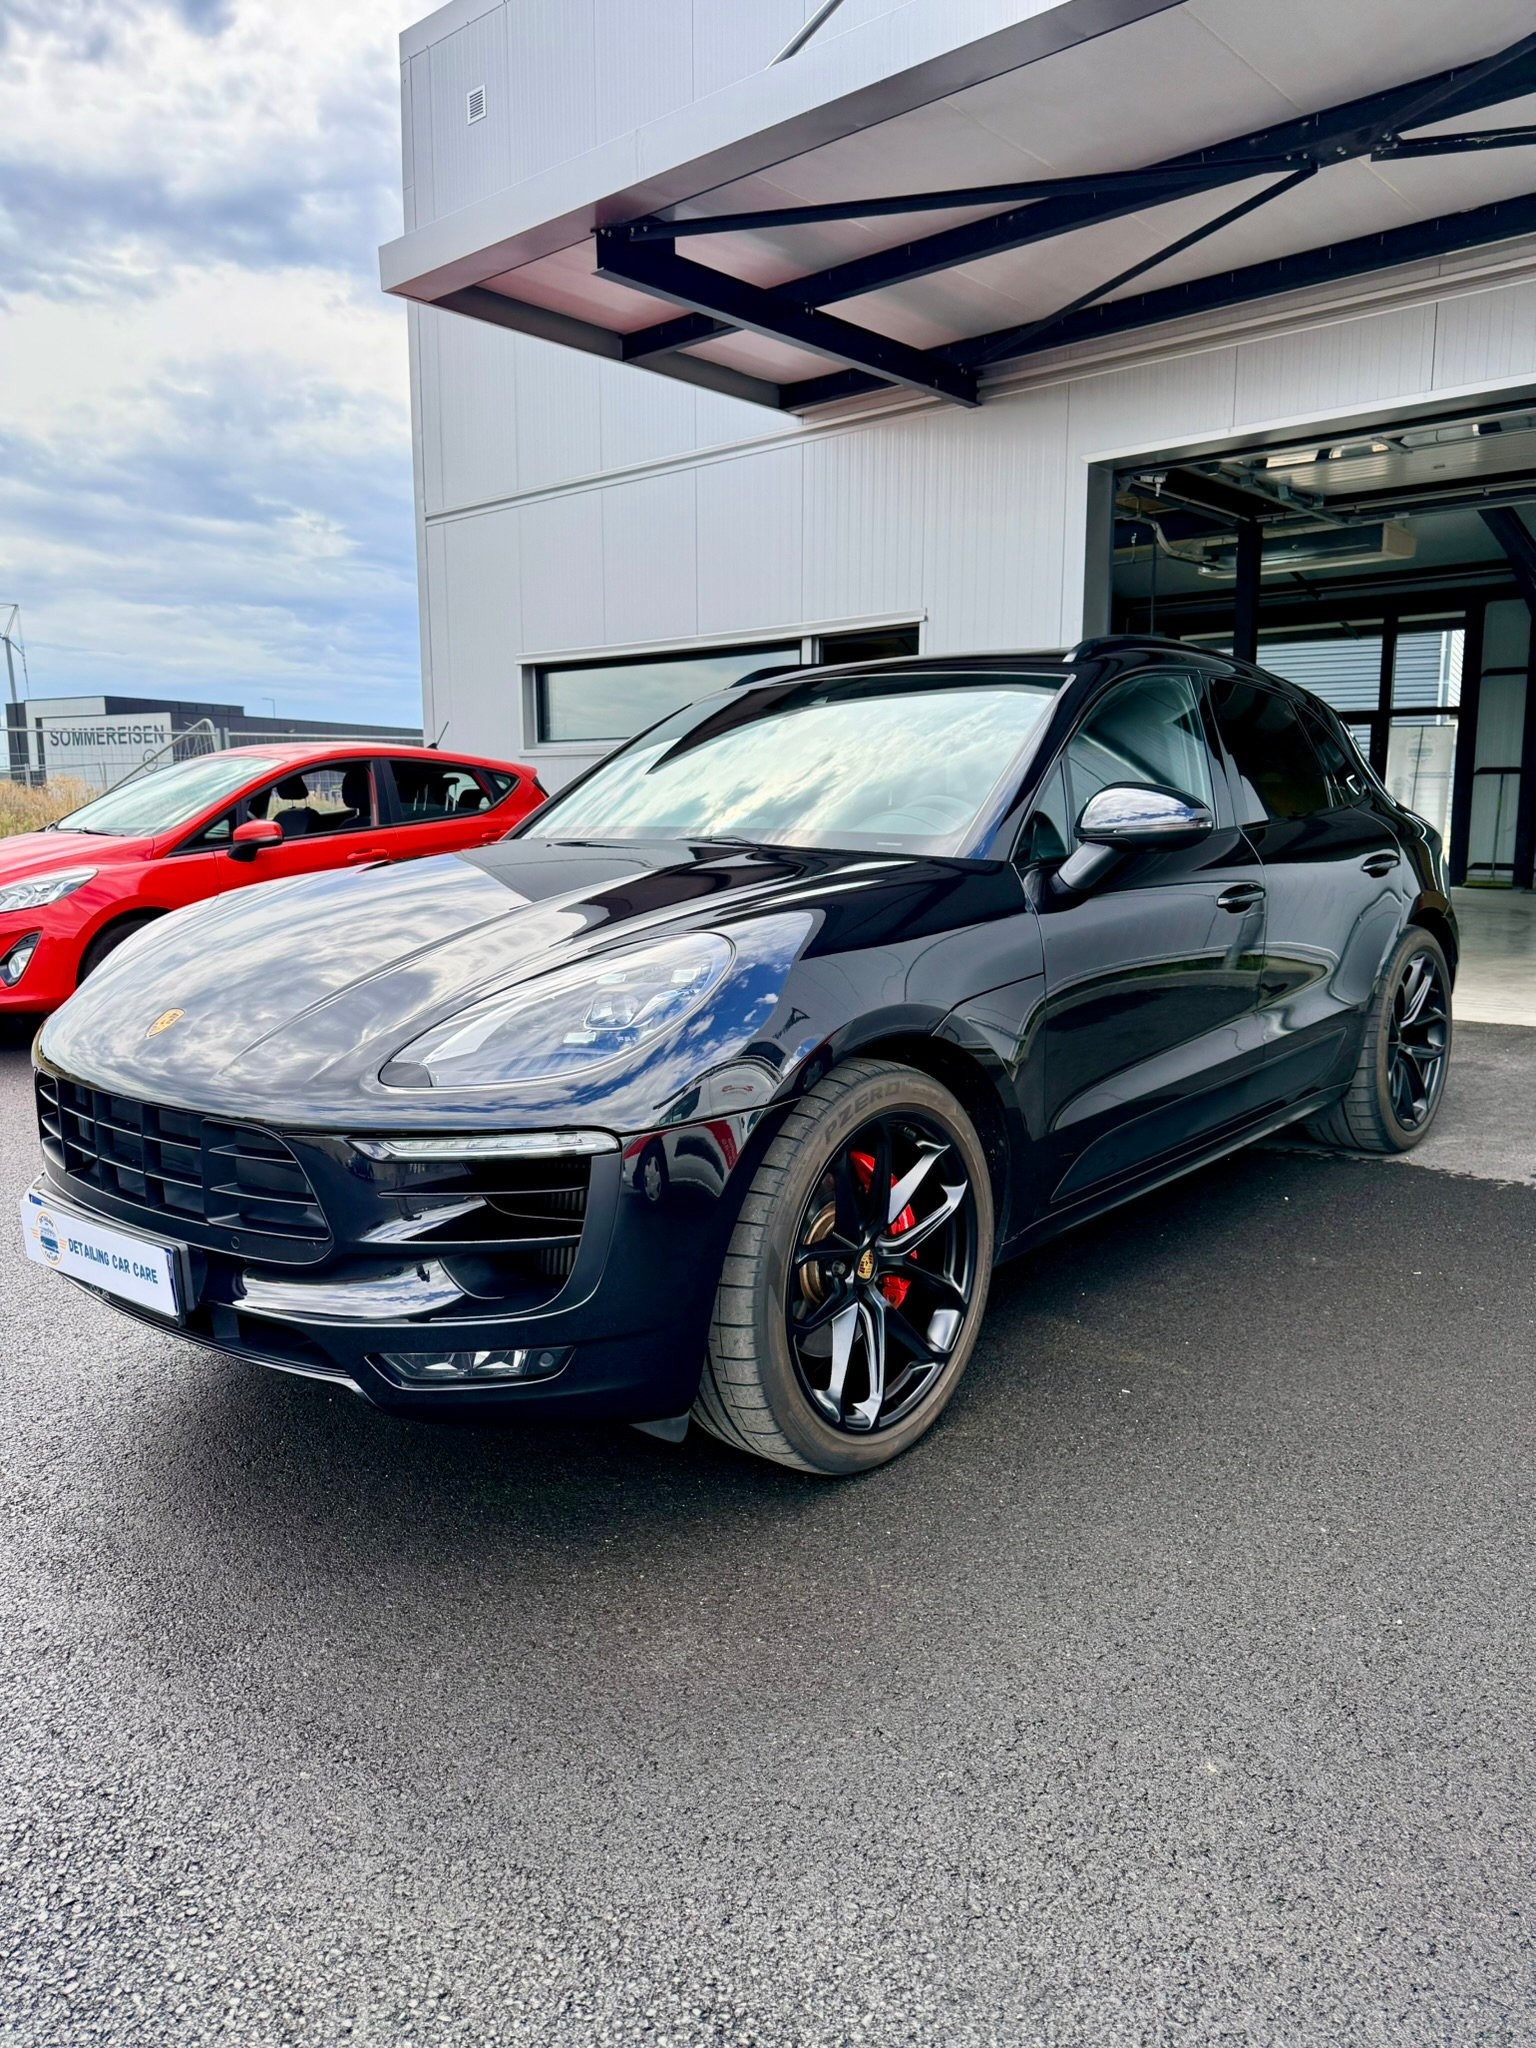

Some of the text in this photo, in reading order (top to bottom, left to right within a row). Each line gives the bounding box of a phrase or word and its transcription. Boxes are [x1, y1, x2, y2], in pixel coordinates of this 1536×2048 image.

[50, 725, 165, 747] SOMMEREISEN
[68, 1238, 110, 1266] DETAILING
[112, 1254, 131, 1274] CAR
[133, 1262, 159, 1284] CARE
